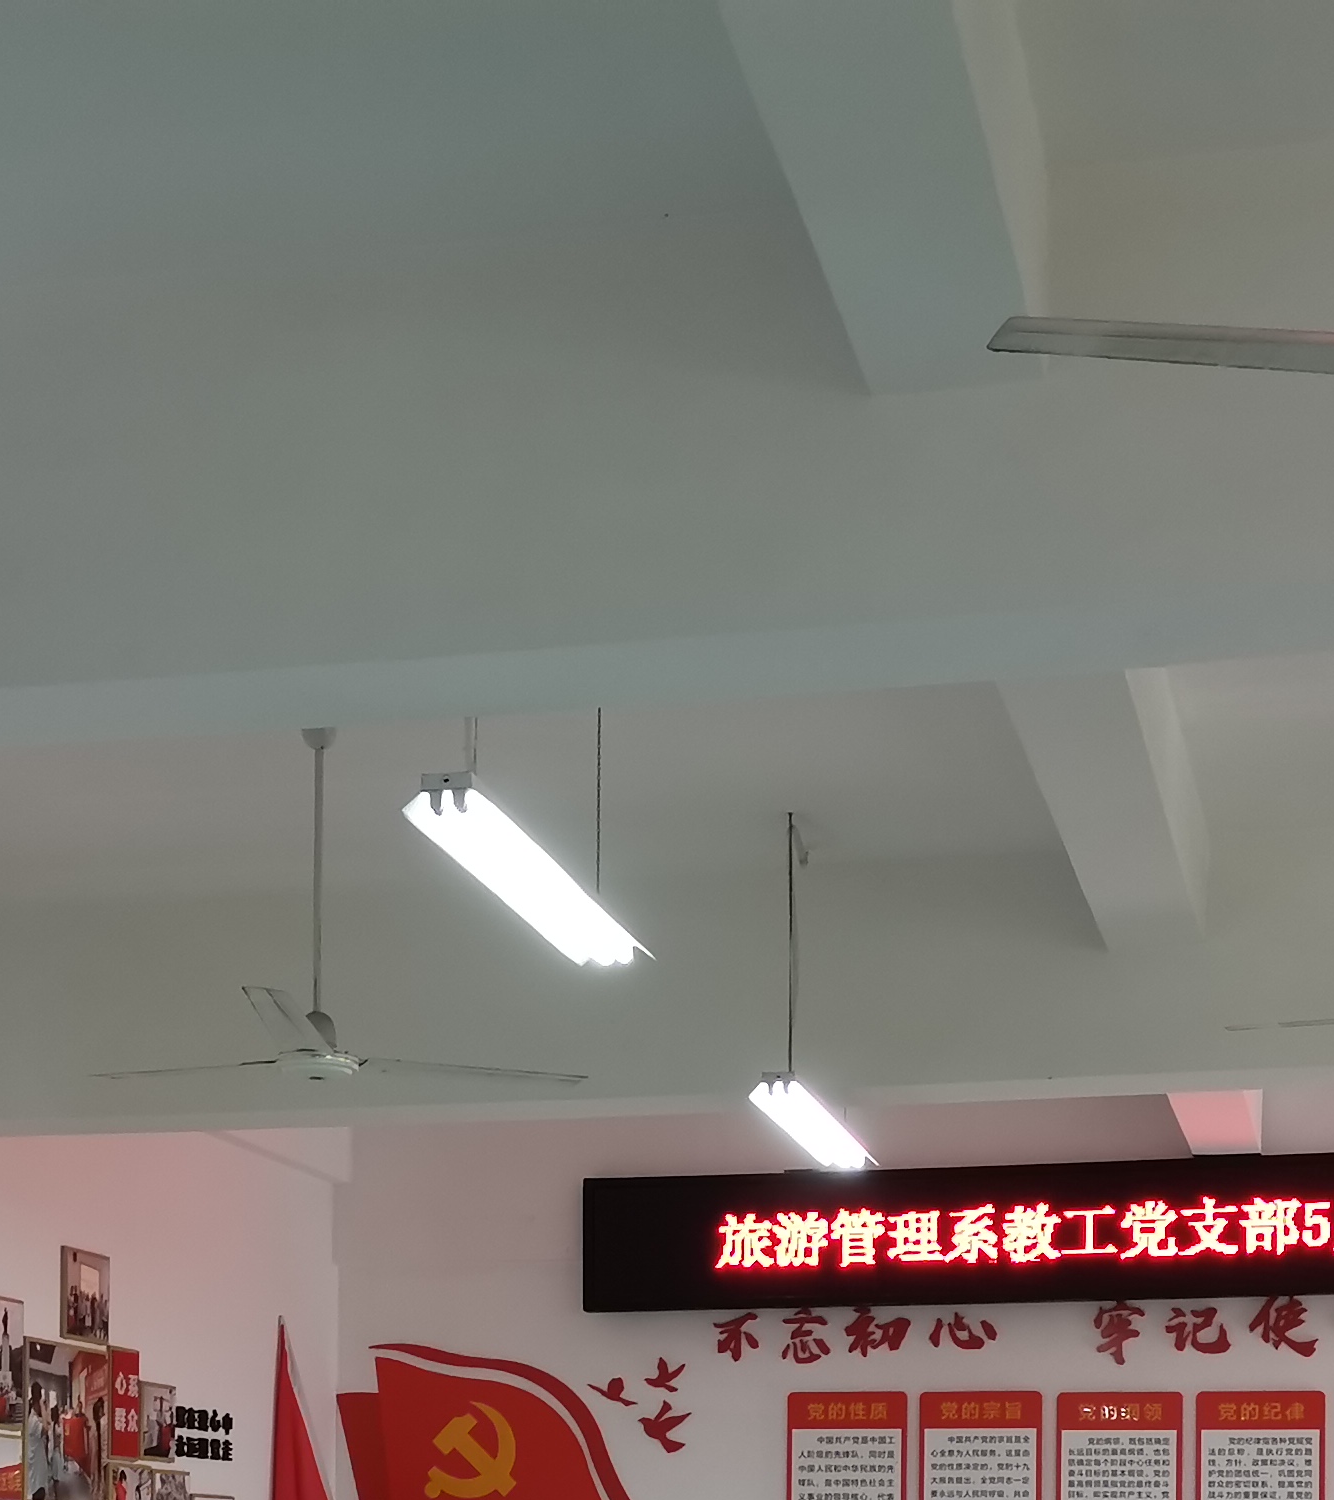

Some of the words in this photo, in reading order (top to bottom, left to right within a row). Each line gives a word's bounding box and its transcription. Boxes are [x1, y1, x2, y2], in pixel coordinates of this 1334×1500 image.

[712, 1303, 997, 1364] 不忘初心
[115, 1406, 139, 1432] 群众
[807, 1402, 888, 1420] 党的性质
[941, 1402, 1022, 1420] 党的宗旨
[1078, 1403, 1162, 1421] 党的纲领
[1218, 1402, 1305, 1421] 党的纪律
